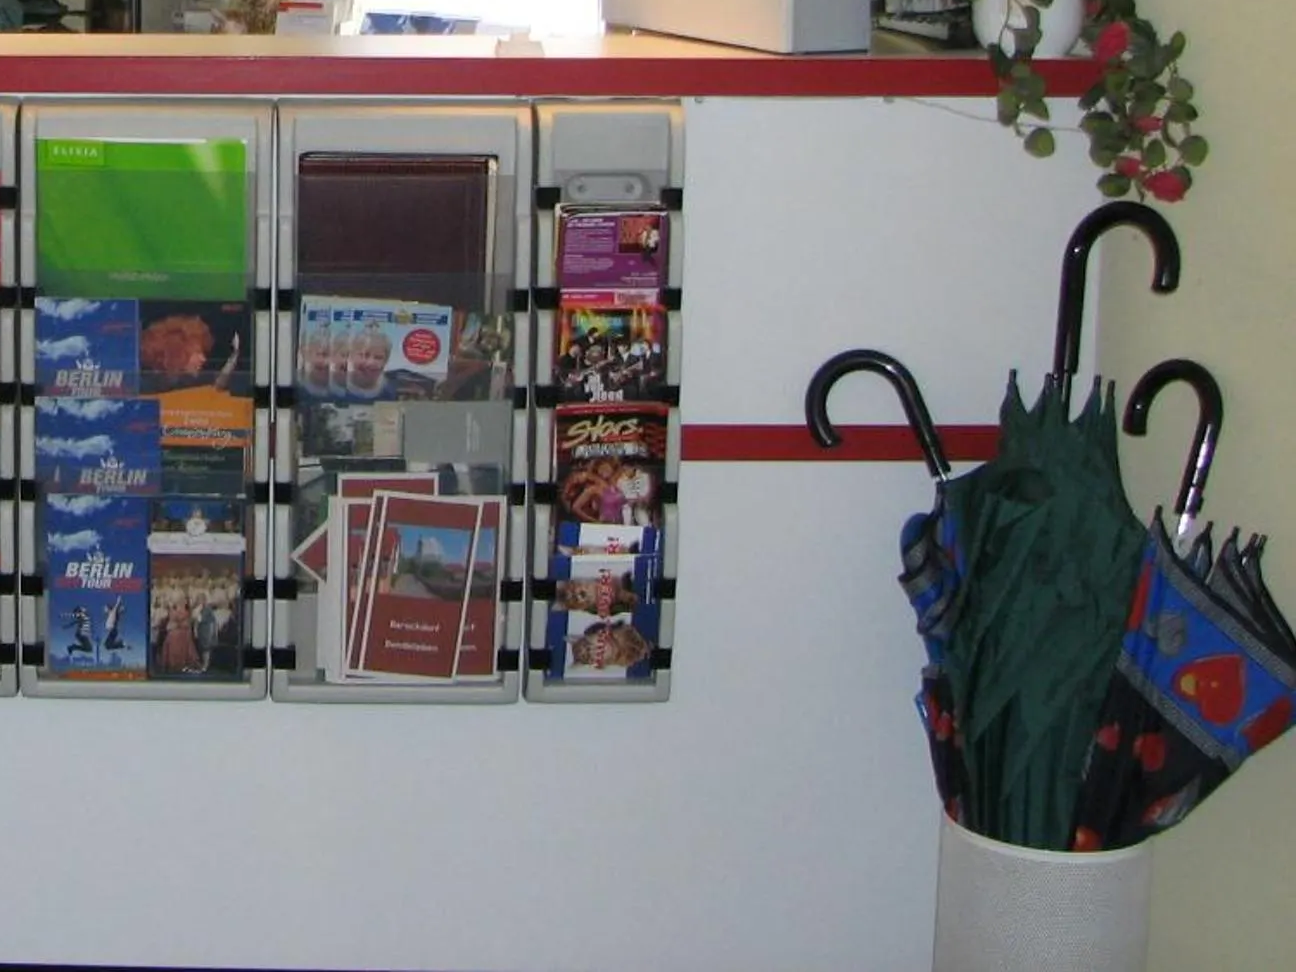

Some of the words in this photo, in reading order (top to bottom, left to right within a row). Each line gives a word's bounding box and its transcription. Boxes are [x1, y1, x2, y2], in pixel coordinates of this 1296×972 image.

[55, 369, 123, 387] BERLIN
[80, 468, 147, 486] BERLIN
[65, 562, 134, 579] BERLIN
[81, 578, 112, 589] TOUR
